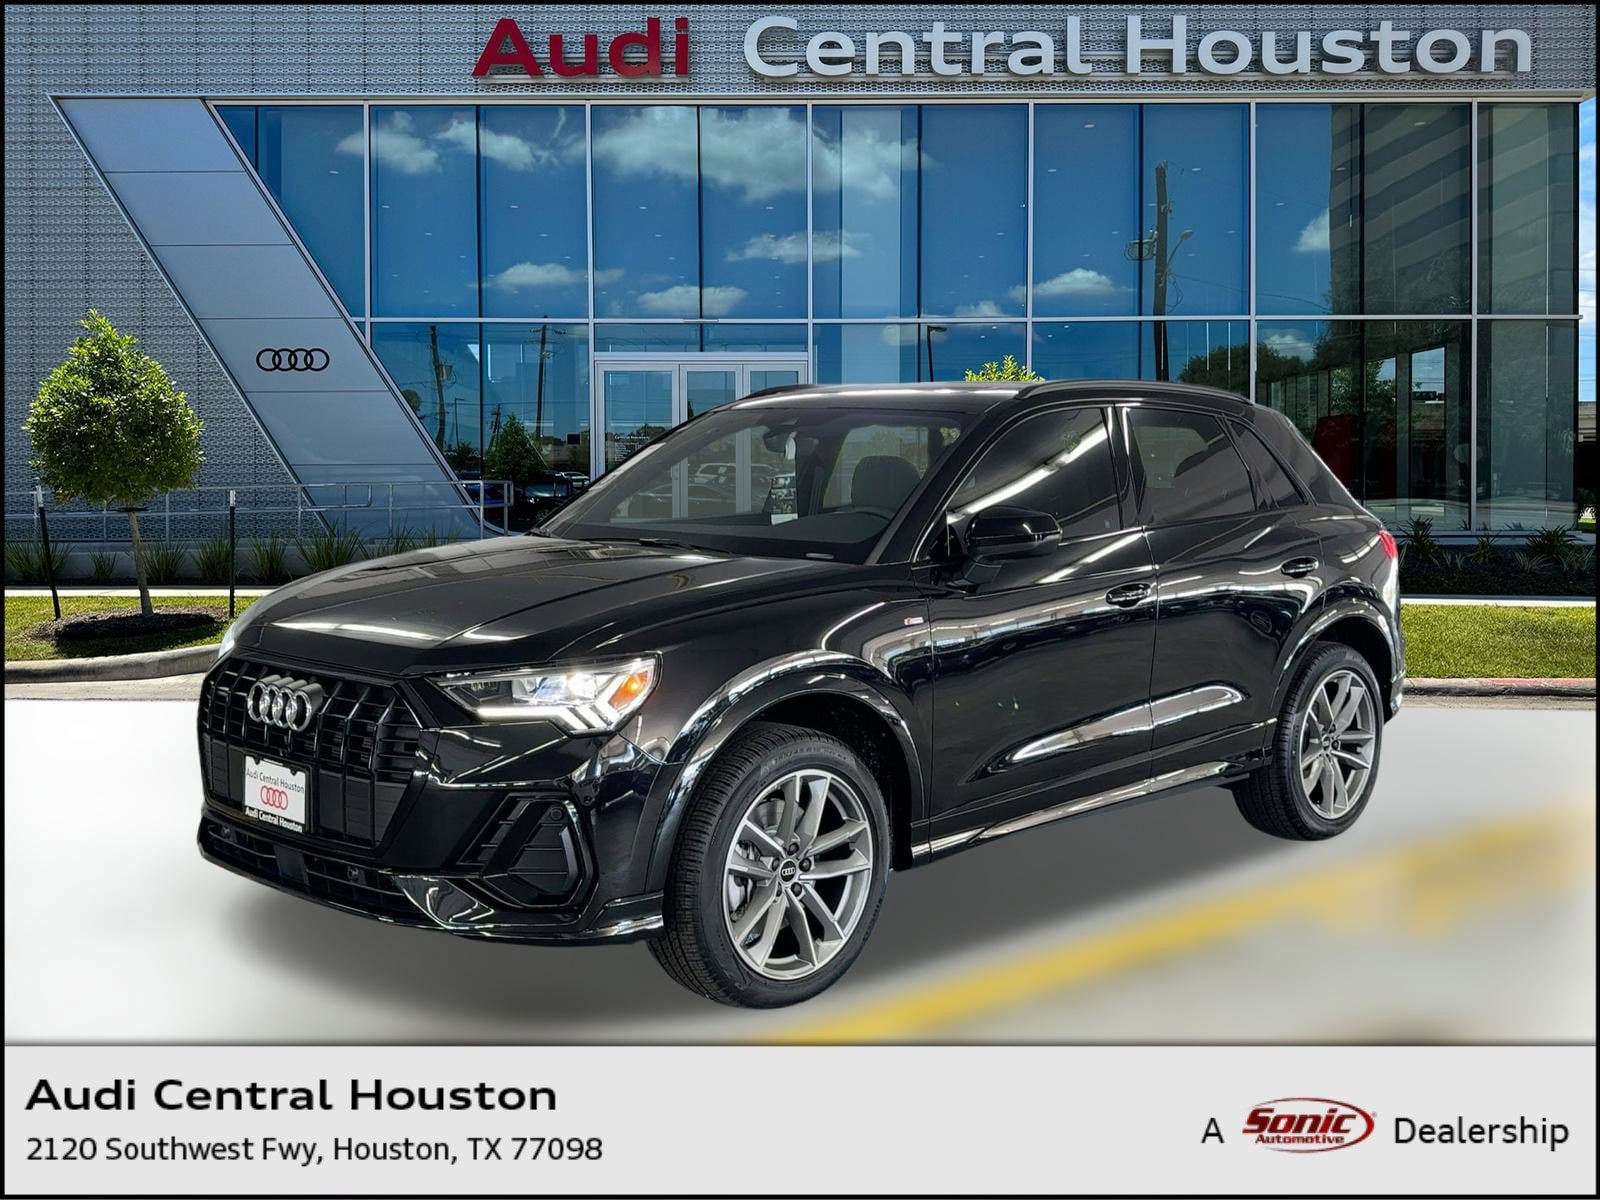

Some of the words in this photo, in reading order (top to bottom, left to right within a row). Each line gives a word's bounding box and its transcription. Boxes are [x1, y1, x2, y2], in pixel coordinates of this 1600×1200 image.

[472, 16, 690, 78] Audi
[743, 15, 1093, 77] Central
[1126, 15, 1532, 75] Houston
[246, 768, 259, 780] Audi
[259, 772, 279, 786] Central
[280, 778, 305, 794] Houston
[245, 806, 258, 818] Audi
[259, 811, 279, 825] Central
[280, 817, 303, 833] Houston
